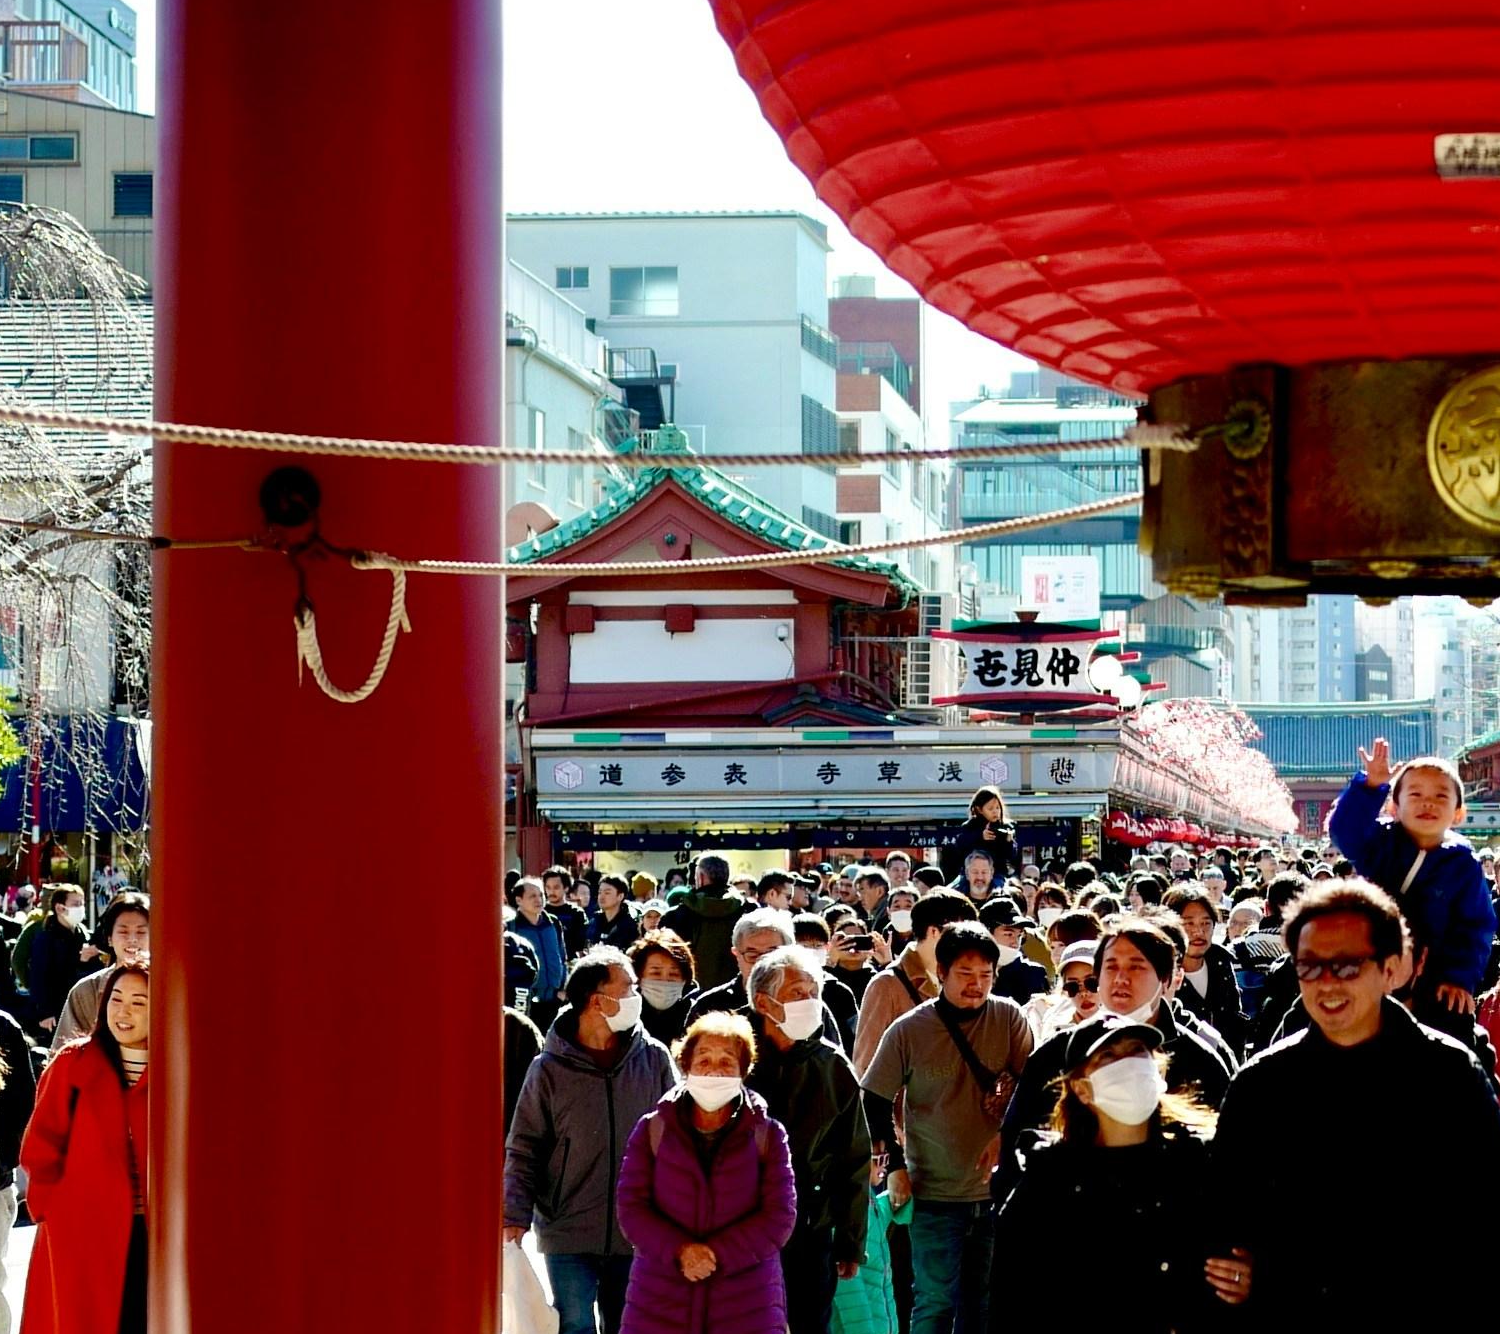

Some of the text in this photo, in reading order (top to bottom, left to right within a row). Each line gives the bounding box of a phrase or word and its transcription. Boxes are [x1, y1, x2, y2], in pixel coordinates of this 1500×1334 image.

[599, 761, 963, 785] 浅草寺 表参道
